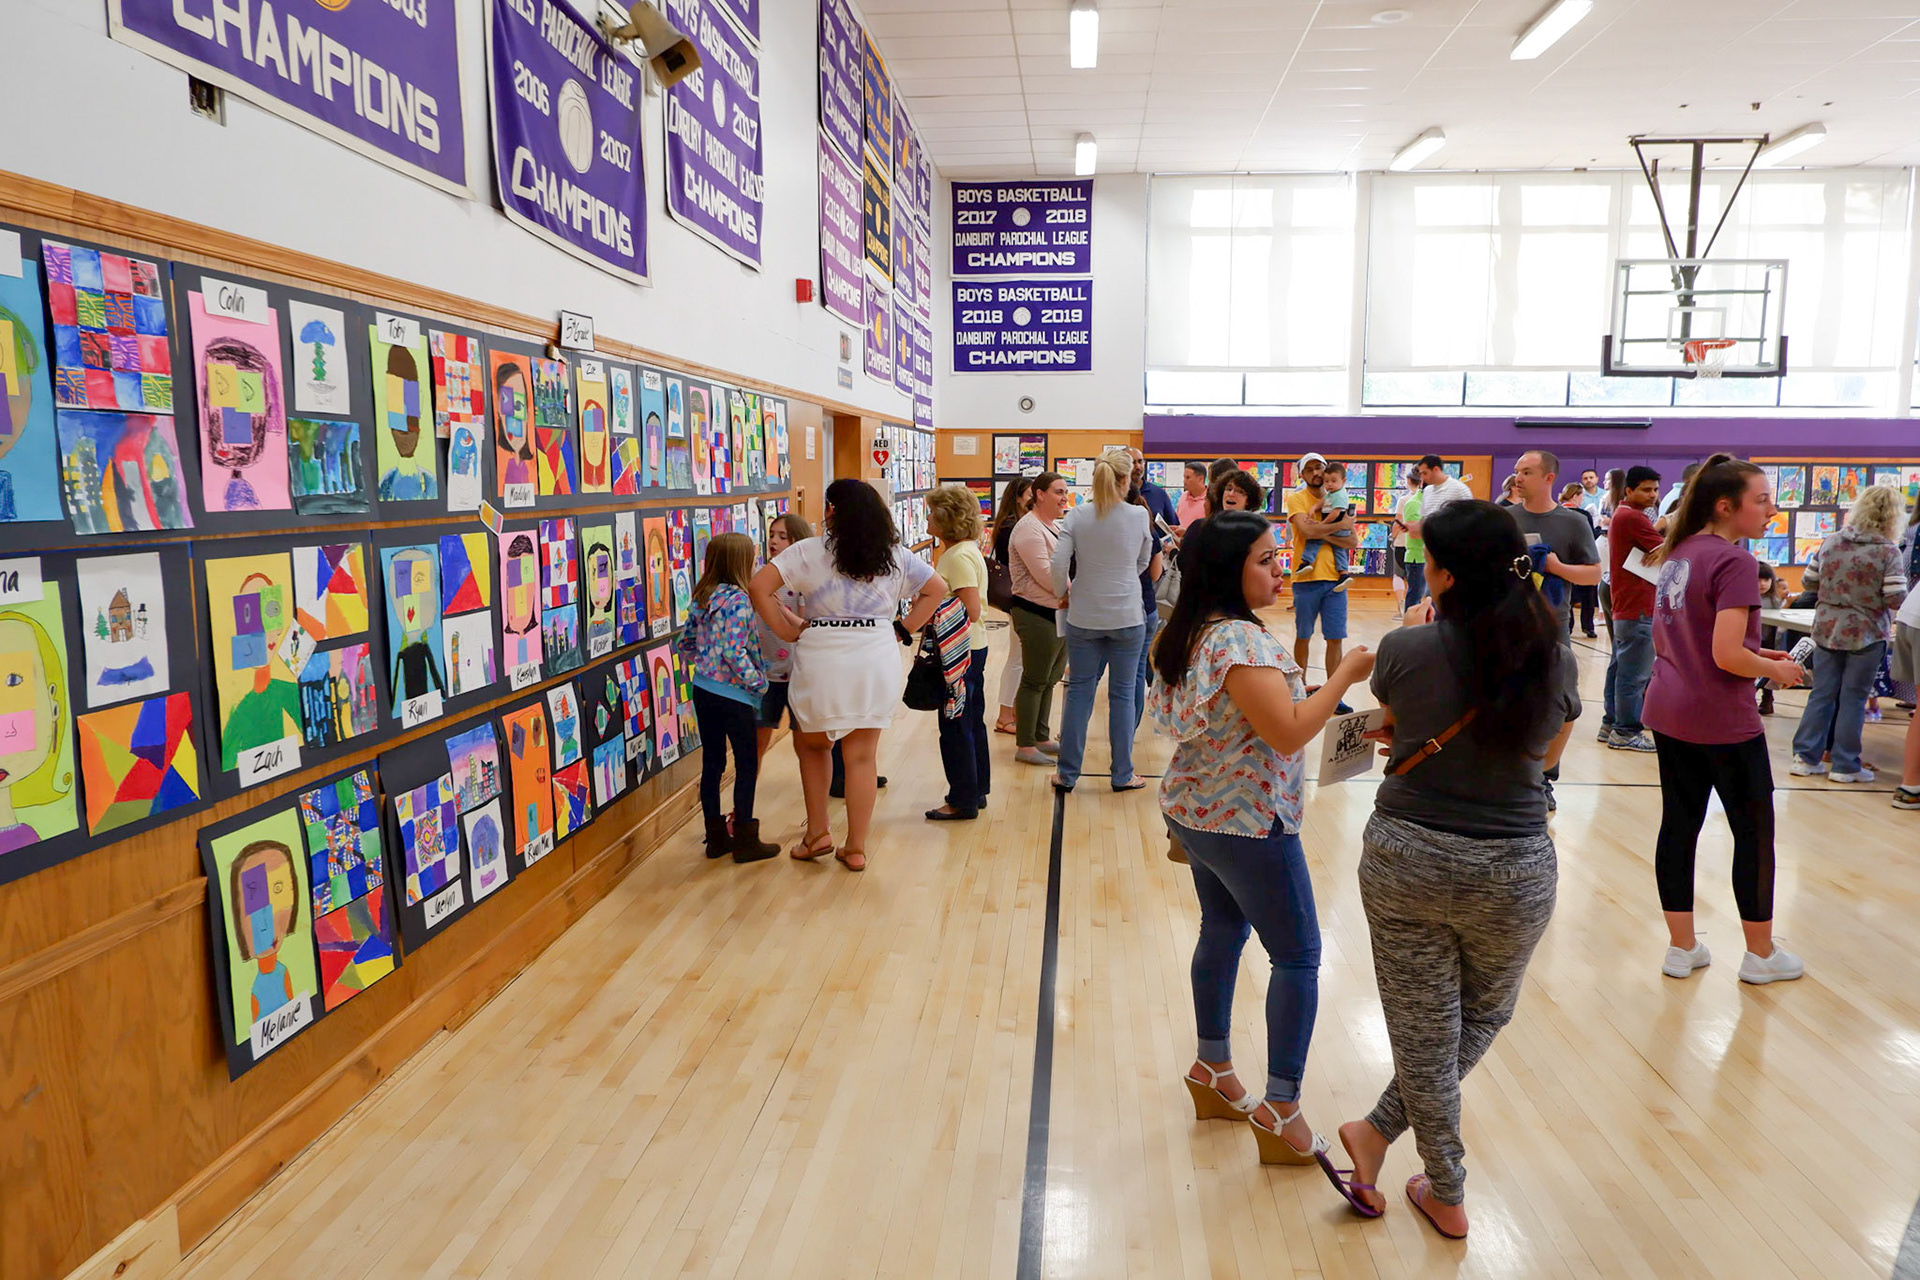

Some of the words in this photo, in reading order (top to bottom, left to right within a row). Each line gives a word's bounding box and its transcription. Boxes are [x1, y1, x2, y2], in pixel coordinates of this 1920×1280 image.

[541, 4, 597, 82] PAROCHIAL
[601, 53, 634, 112] LEAGUE
[700, 9, 760, 102] BASKETBALL
[173, 0, 440, 154] CHAMPIONS
[514, 60, 550, 117] 2006
[600, 130, 631, 173] 2007
[733, 102, 758, 151] 2017
[512, 146, 634, 258] CHAMPIONS
[684, 162, 758, 244] CHAMPIONS
[957, 189, 992, 203] BOYS
[997, 188, 1087, 202] BASKETBALL
[957, 210, 998, 224] 2017
[1046, 208, 1087, 224] 2018
[955, 232, 996, 246] DANBURY
[1000, 232, 1048, 246] PAROCHIAL
[1052, 230, 1088, 244] LEAGUE
[968, 252, 1076, 266] CHAMPIONS
[218, 286, 245, 314] Colin
[957, 288, 992, 302] BOYS
[998, 287, 1087, 302] BASKETBALL
[962, 310, 1003, 324] 2018
[1041, 309, 1082, 324] 2019
[387, 318, 406, 343] Toby
[956, 332, 996, 346] DANBURY
[1001, 331, 1049, 345] PAROCHIAL
[1054, 330, 1089, 344] LEAGUE
[969, 350, 1076, 366] CHAMPIONS
[874, 440, 888, 448] AED
[408, 700, 428, 723] Ryan
[253, 745, 284, 774] Zach
[1328, 754, 1344, 763] ART
[1347, 742, 1370, 755] SHOW
[260, 1001, 302, 1048] Melanie
